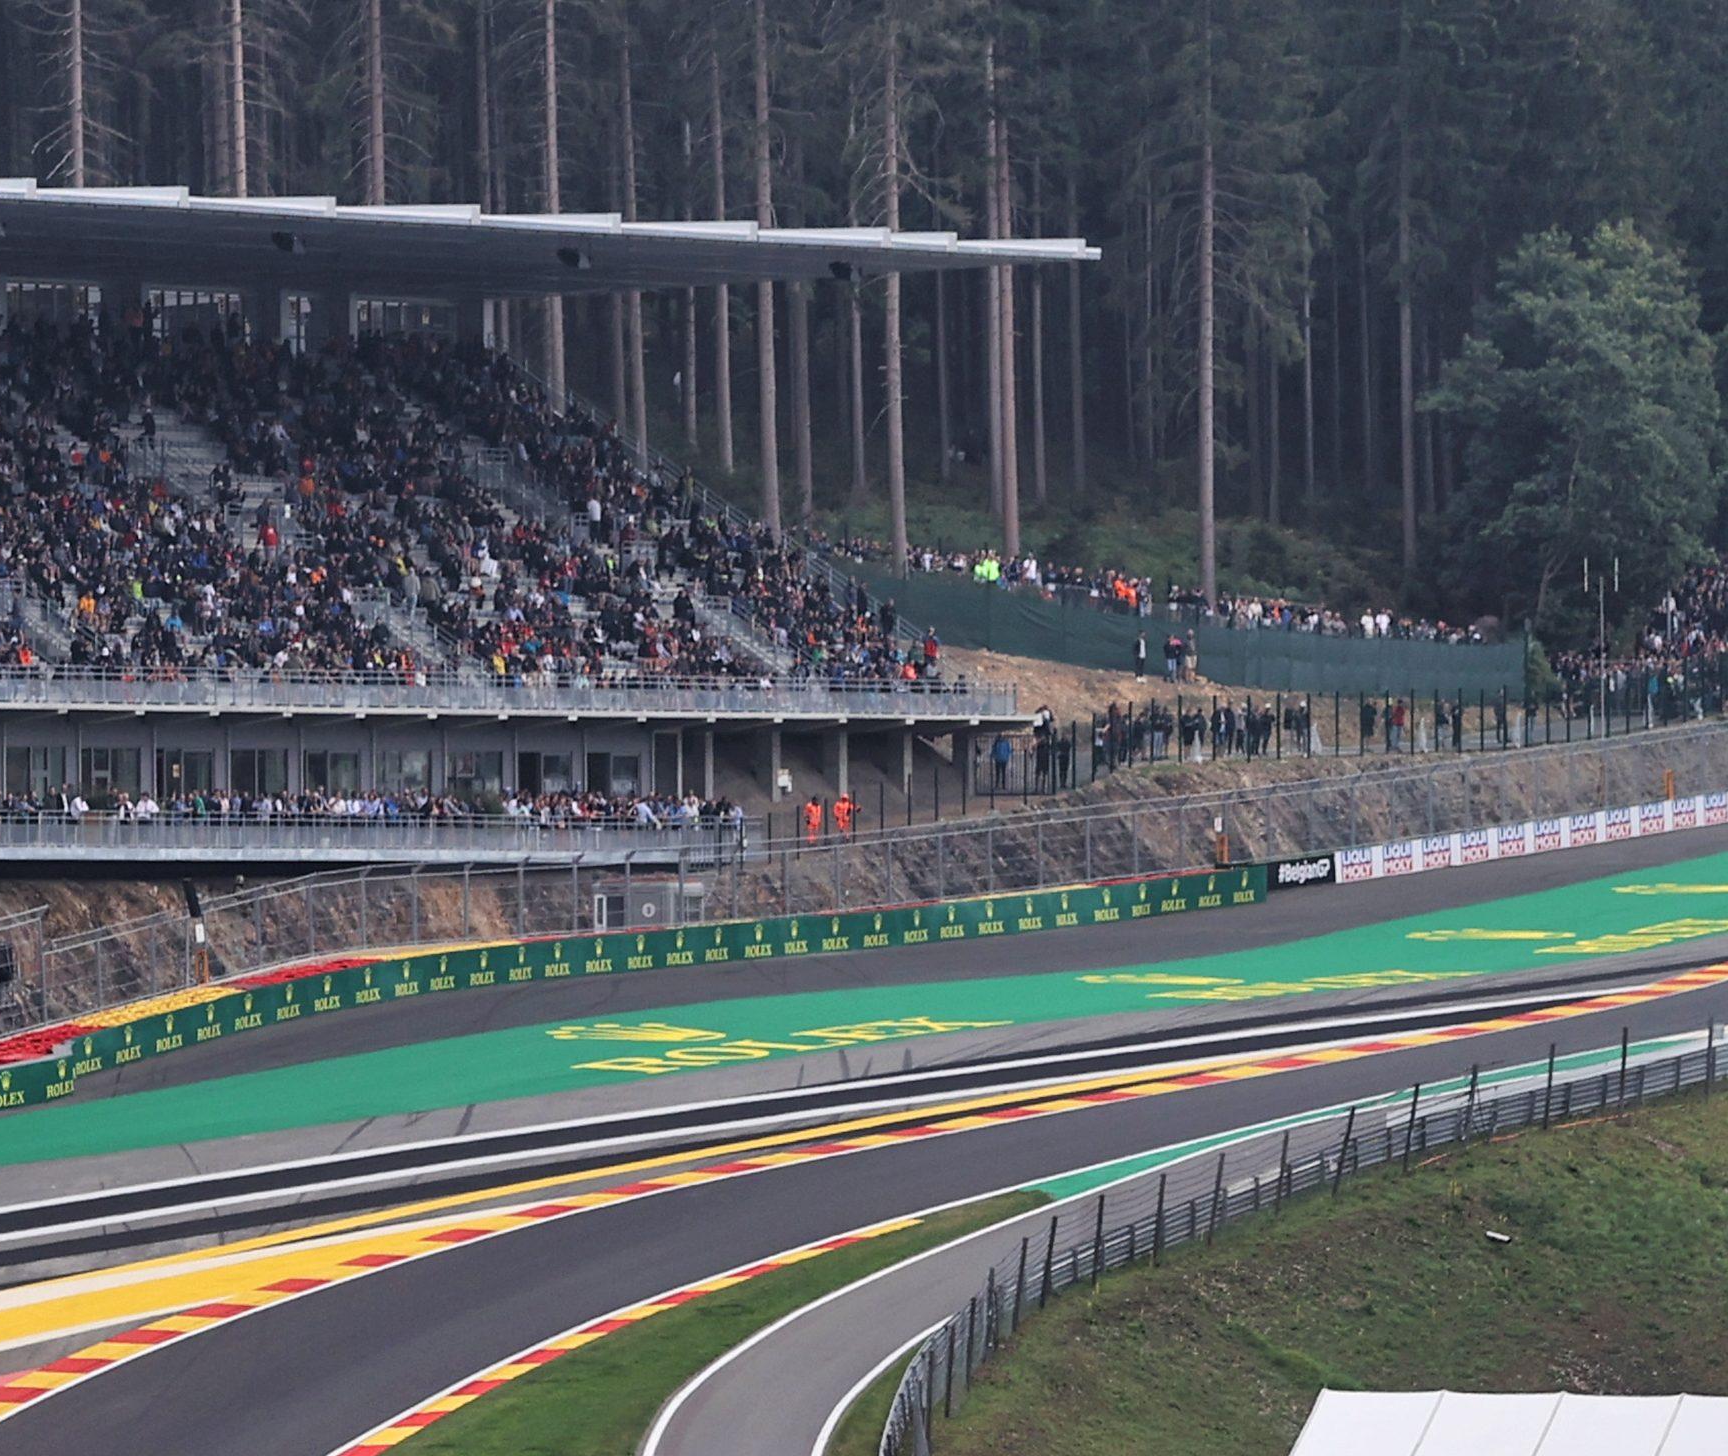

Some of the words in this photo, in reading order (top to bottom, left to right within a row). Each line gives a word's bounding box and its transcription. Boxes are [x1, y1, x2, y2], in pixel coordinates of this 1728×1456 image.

[1342, 847, 1372, 863] LIQUI
[1343, 862, 1373, 880] MOLY
[314, 996, 340, 1012] ROLEX
[356, 988, 380, 1004] ROLEX
[277, 1004, 300, 1020] ROLEX
[235, 1013, 262, 1031] ROLEX
[196, 1023, 221, 1041] ROLEX
[156, 1034, 183, 1052] ROLEX
[570, 1016, 1014, 1074] ROLEX
[116, 1045, 141, 1063] ROLEX
[75, 1057, 102, 1076] ROLEX
